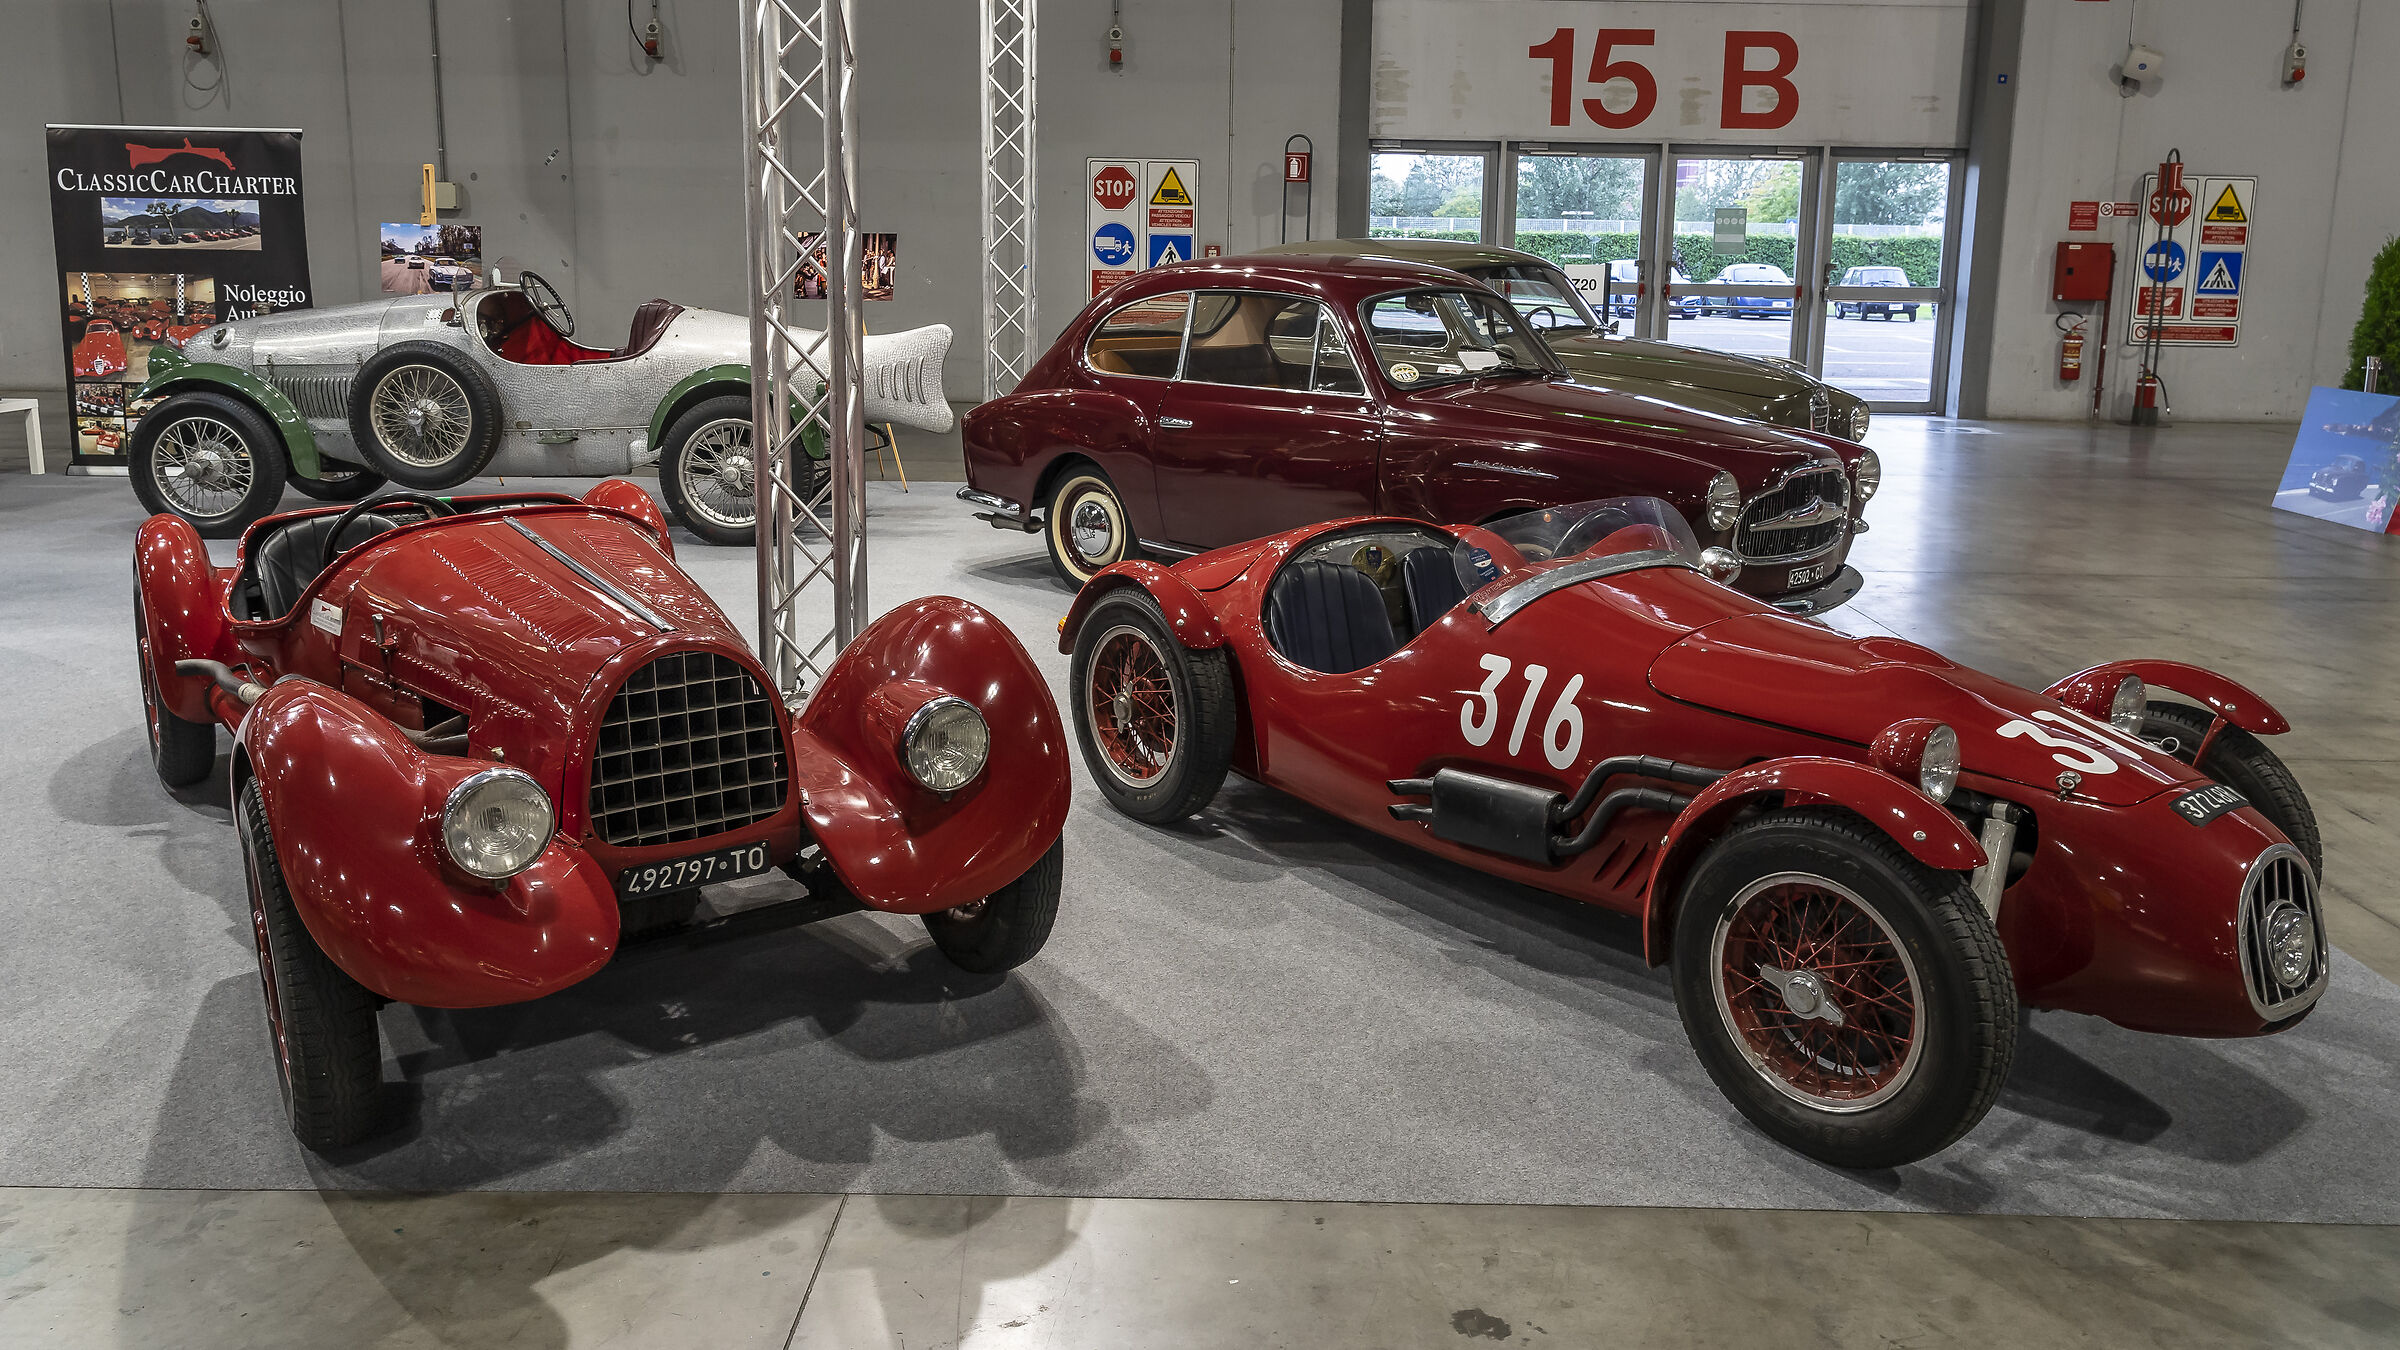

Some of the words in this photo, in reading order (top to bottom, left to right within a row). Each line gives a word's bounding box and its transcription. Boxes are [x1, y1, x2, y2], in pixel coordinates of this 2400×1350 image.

[1528, 27, 1658, 130] 15
[1720, 30, 1800, 130] B
[1095, 179, 1135, 197] STOP
[223, 284, 306, 307] Noleggio
[225, 305, 258, 322] Aut
[1460, 653, 1584, 770] 316
